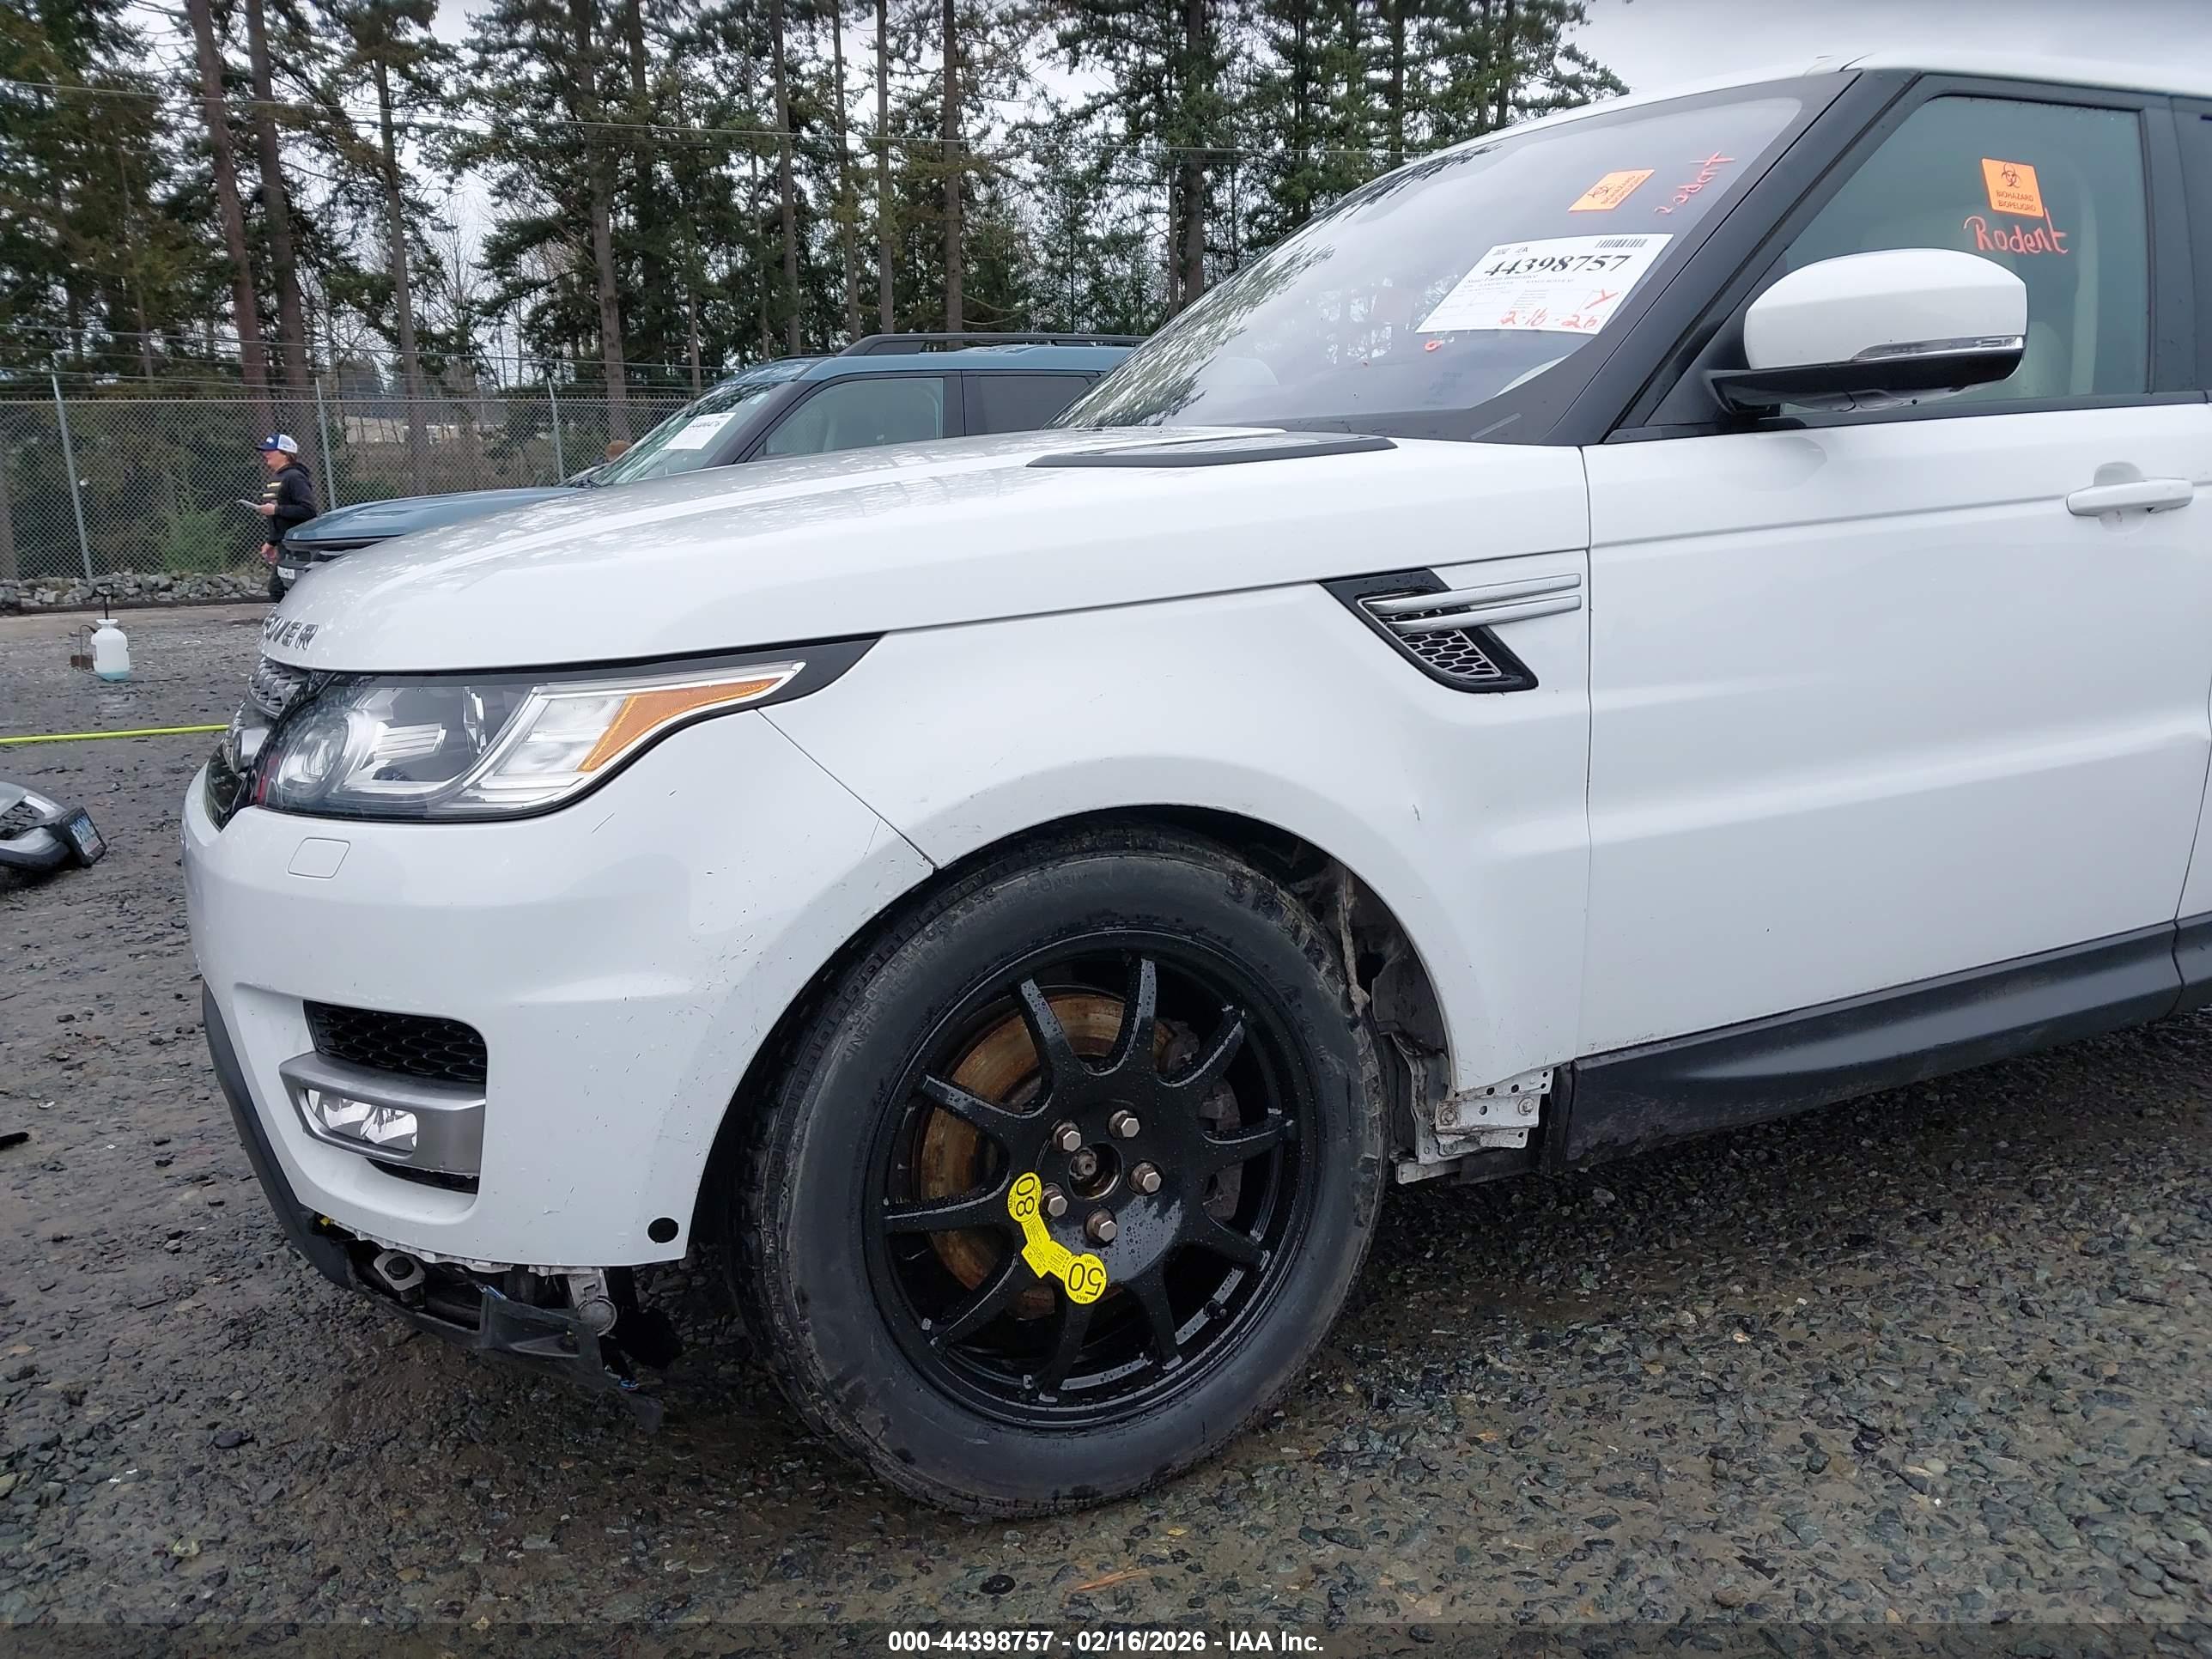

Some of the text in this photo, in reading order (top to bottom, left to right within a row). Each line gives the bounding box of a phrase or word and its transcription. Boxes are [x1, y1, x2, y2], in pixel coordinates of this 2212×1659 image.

[1996, 190, 2034, 202] BIOHAZARD
[1998, 200, 2036, 211] BIOPELIGRO
[1963, 207, 2069, 254] Rodent
[1485, 254, 1632, 276] 44398757
[1068, 1262, 1104, 1297] 50
